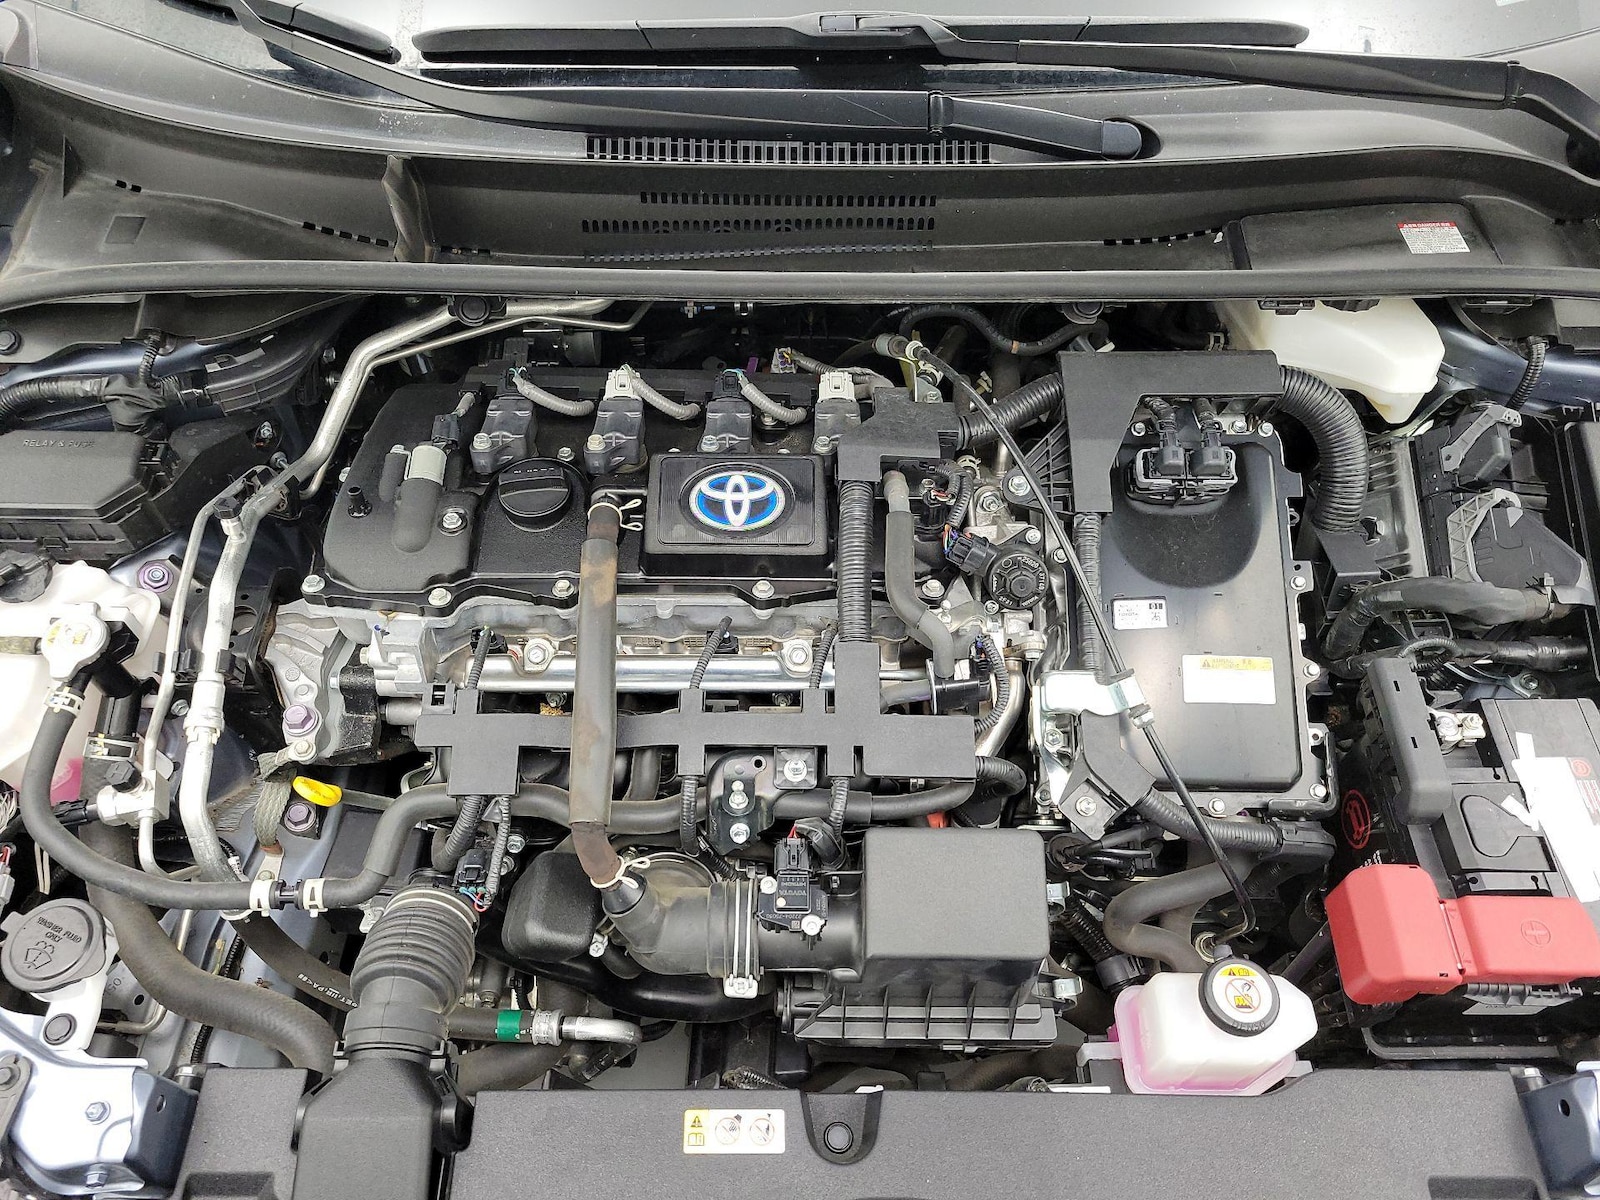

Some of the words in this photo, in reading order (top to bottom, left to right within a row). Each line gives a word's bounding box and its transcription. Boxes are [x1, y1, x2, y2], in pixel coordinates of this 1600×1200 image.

[23, 439, 57, 448] RELAY
[58, 440, 65, 448] &
[37, 916, 64, 934] WASHER
[63, 930, 82, 943] FLUID
[45, 931, 63, 943] ONLY
[1231, 1020, 1266, 1032] DENSO
